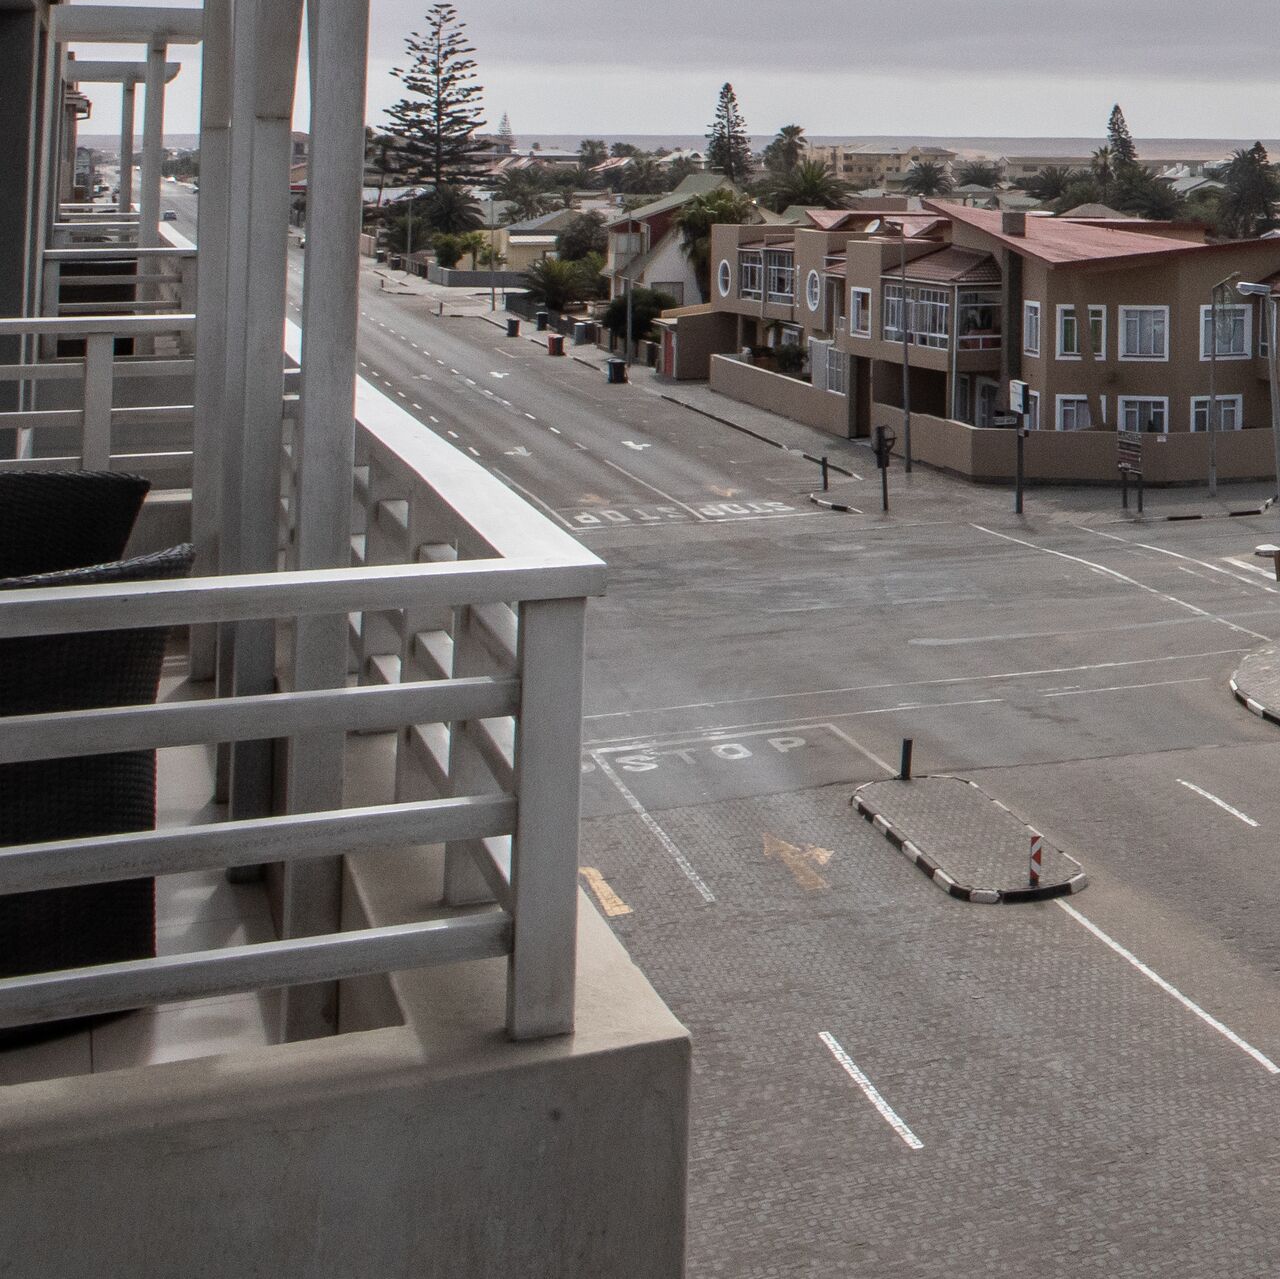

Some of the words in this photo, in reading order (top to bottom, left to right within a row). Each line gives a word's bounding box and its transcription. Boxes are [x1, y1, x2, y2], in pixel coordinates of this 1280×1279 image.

[574, 506, 687, 524] STOP
[699, 501, 795, 517] STOP
[615, 736, 806, 772] STOP
